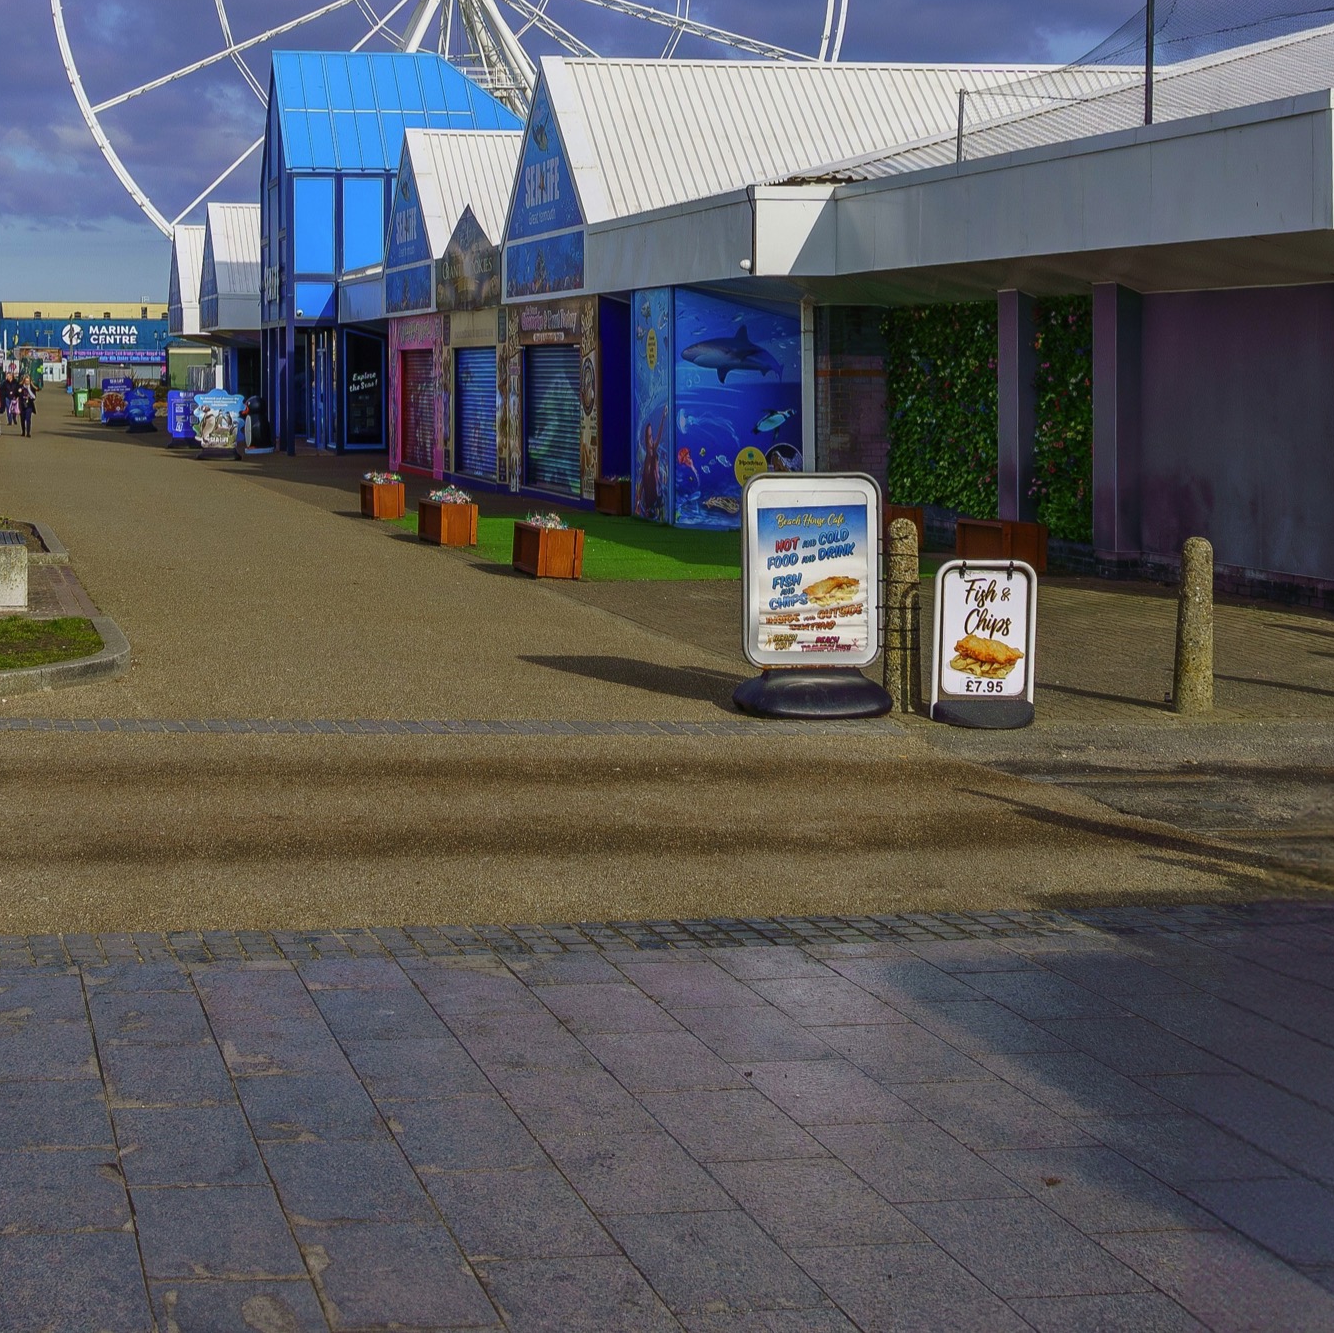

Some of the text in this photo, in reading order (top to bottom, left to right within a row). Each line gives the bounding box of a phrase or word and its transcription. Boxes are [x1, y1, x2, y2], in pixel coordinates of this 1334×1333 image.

[525, 163, 542, 209] SEA
[89, 325, 138, 335] MARINA
[90, 335, 137, 344] CENTRE
[353, 371, 377, 381] Explore
[349, 384, 360, 393] the
[776, 513, 844, 528] Beach House Cafe
[775, 528, 849, 553] HOT AND COLD
[767, 542, 855, 570] FOOD AND DRINK
[772, 573, 802, 590] FISH
[780, 587, 795, 596] AND
[964, 578, 1011, 608] Fish &
[769, 592, 808, 610] CHIPS
[817, 603, 864, 620] OUTSIDE
[964, 608, 1012, 639] Chips
[815, 636, 840, 644] BEACH
[965, 680, 1003, 693] £7.95
